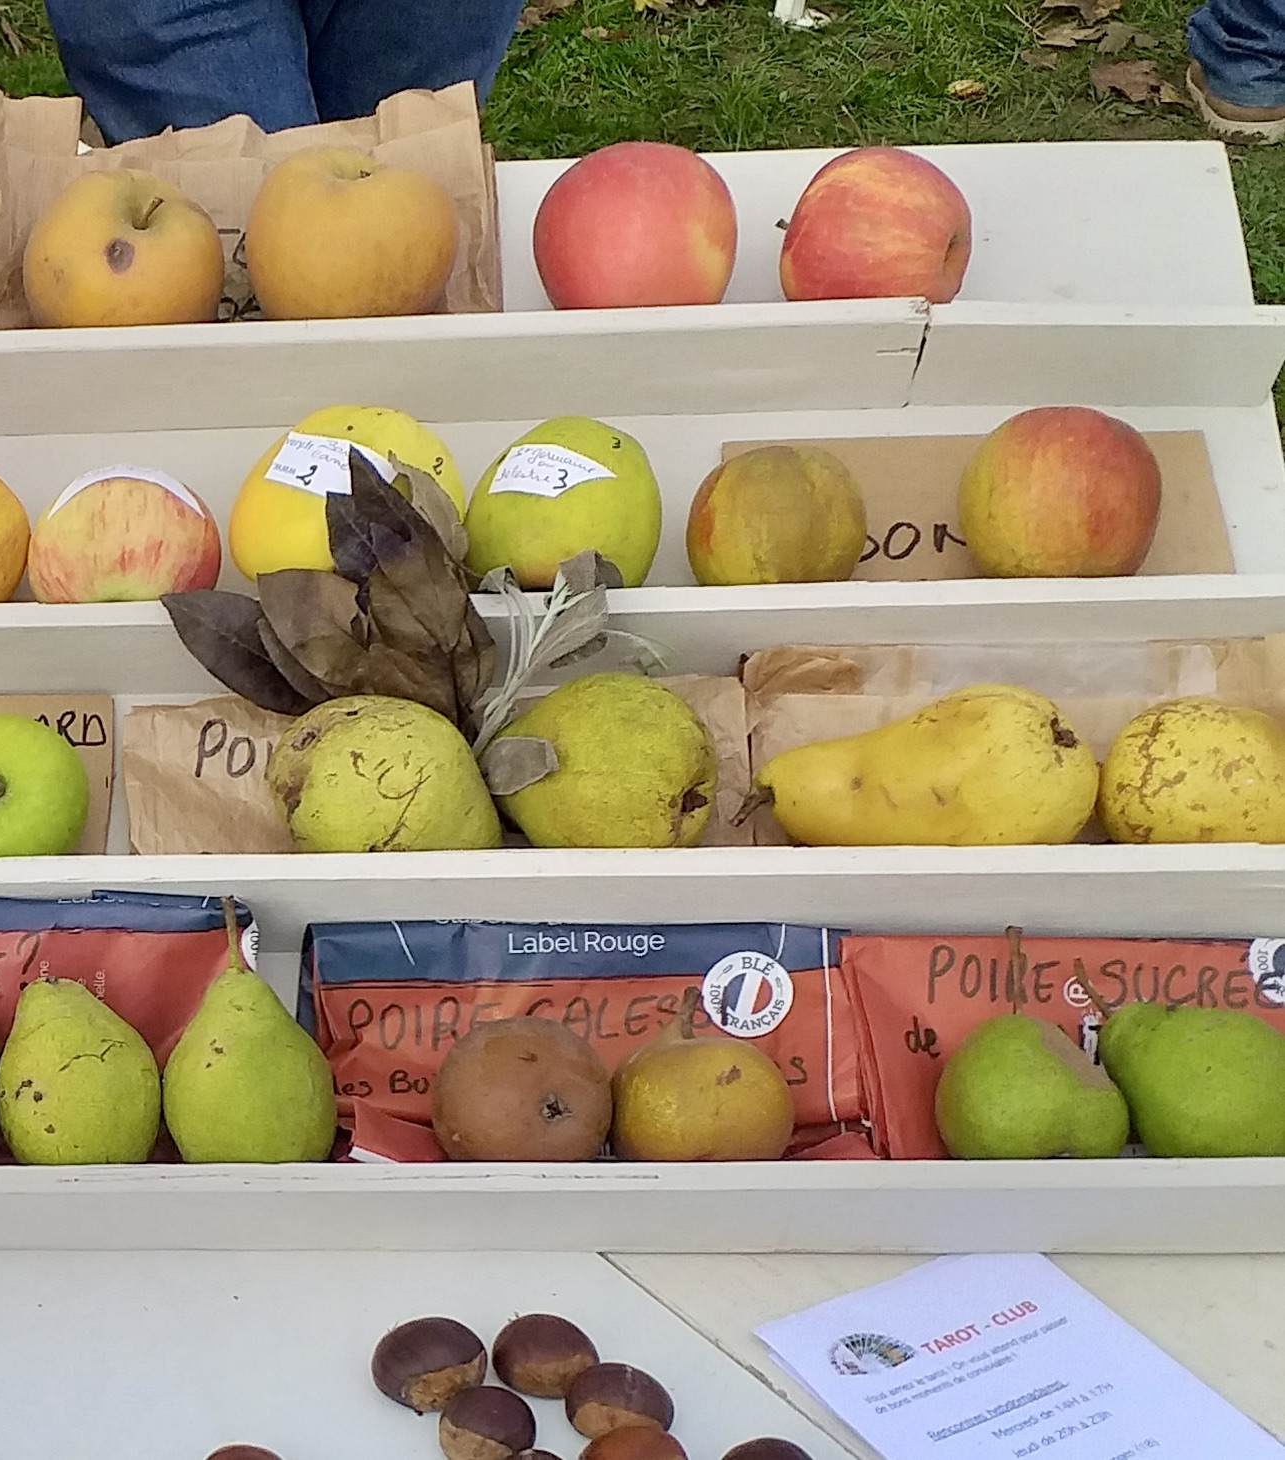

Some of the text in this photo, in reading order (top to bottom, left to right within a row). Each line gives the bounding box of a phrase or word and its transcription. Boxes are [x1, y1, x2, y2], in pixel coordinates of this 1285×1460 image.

[611, 436, 622, 449] 3
[290, 464, 319, 486] 2
[431, 457, 445, 476] 2
[552, 468, 569, 490] 3
[508, 931, 666, 958] Label Rouge
[741, 956, 776, 977] BLÉ
[928, 944, 1061, 1005] POIRE
[904, 1015, 940, 1059] de
[919, 1323, 982, 1355] TAROT
[991, 1300, 1038, 1326] CLUB
[991, 1415, 1040, 1440] Mercredi
